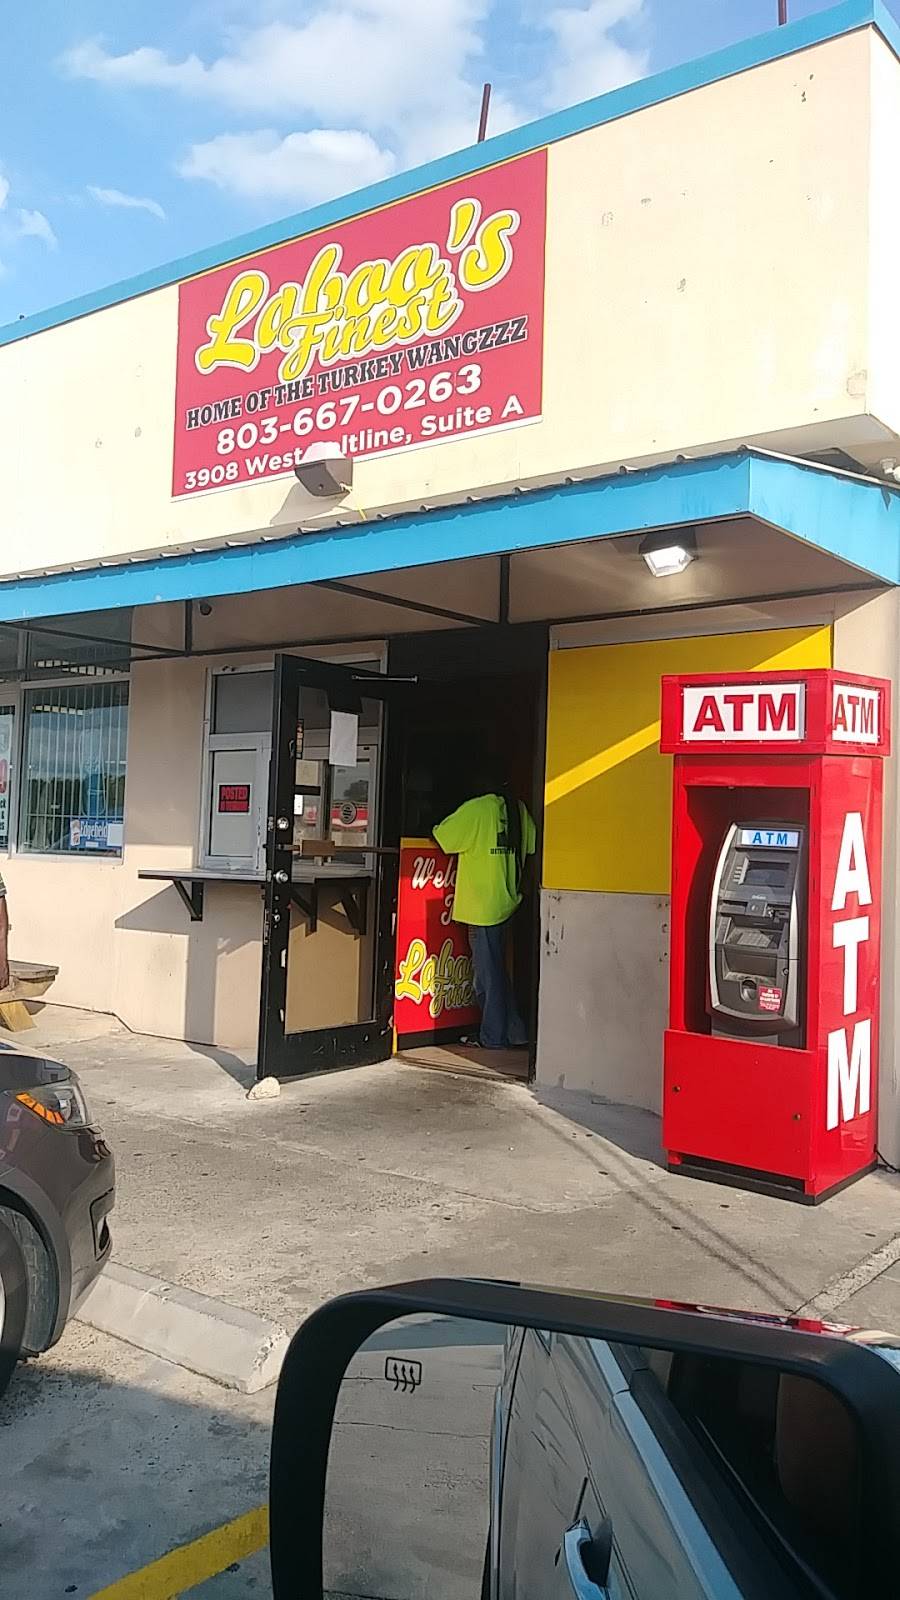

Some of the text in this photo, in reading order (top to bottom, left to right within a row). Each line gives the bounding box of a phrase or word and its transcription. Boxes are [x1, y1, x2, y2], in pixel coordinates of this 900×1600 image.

[187, 318, 528, 429] HOME OF THE TURKEY WANGZZZ
[278, 276, 458, 382] Finest
[184, 395, 524, 490] 3908 West ltline, Suite A
[216, 363, 482, 455] 803-667-0263
[692, 693, 797, 732] ATM
[833, 693, 874, 734] ATM
[220, 786, 248, 801] POSTED
[751, 831, 789, 846] ATM
[826, 811, 873, 1131] ATM
